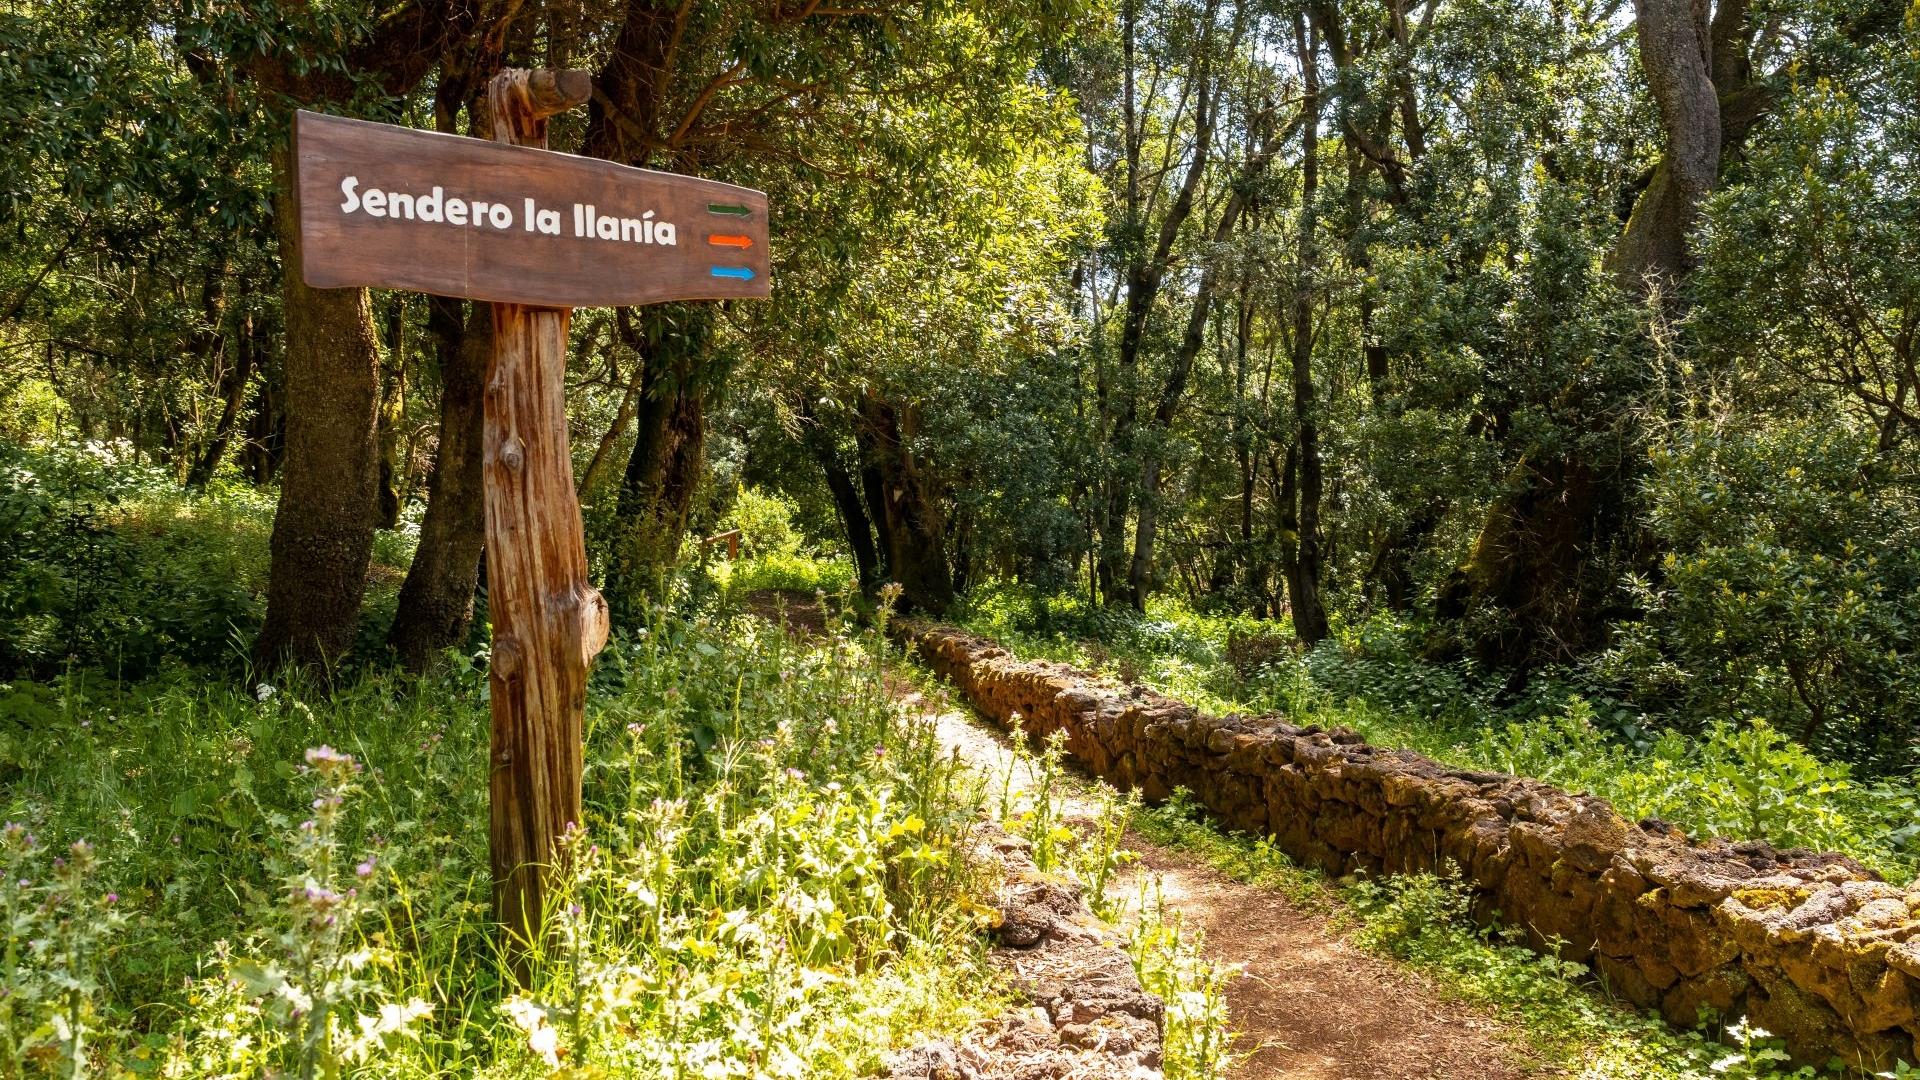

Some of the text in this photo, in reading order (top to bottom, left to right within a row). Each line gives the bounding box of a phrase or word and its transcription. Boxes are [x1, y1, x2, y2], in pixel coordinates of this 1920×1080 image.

[340, 175, 677, 246] Sendero la llanía
